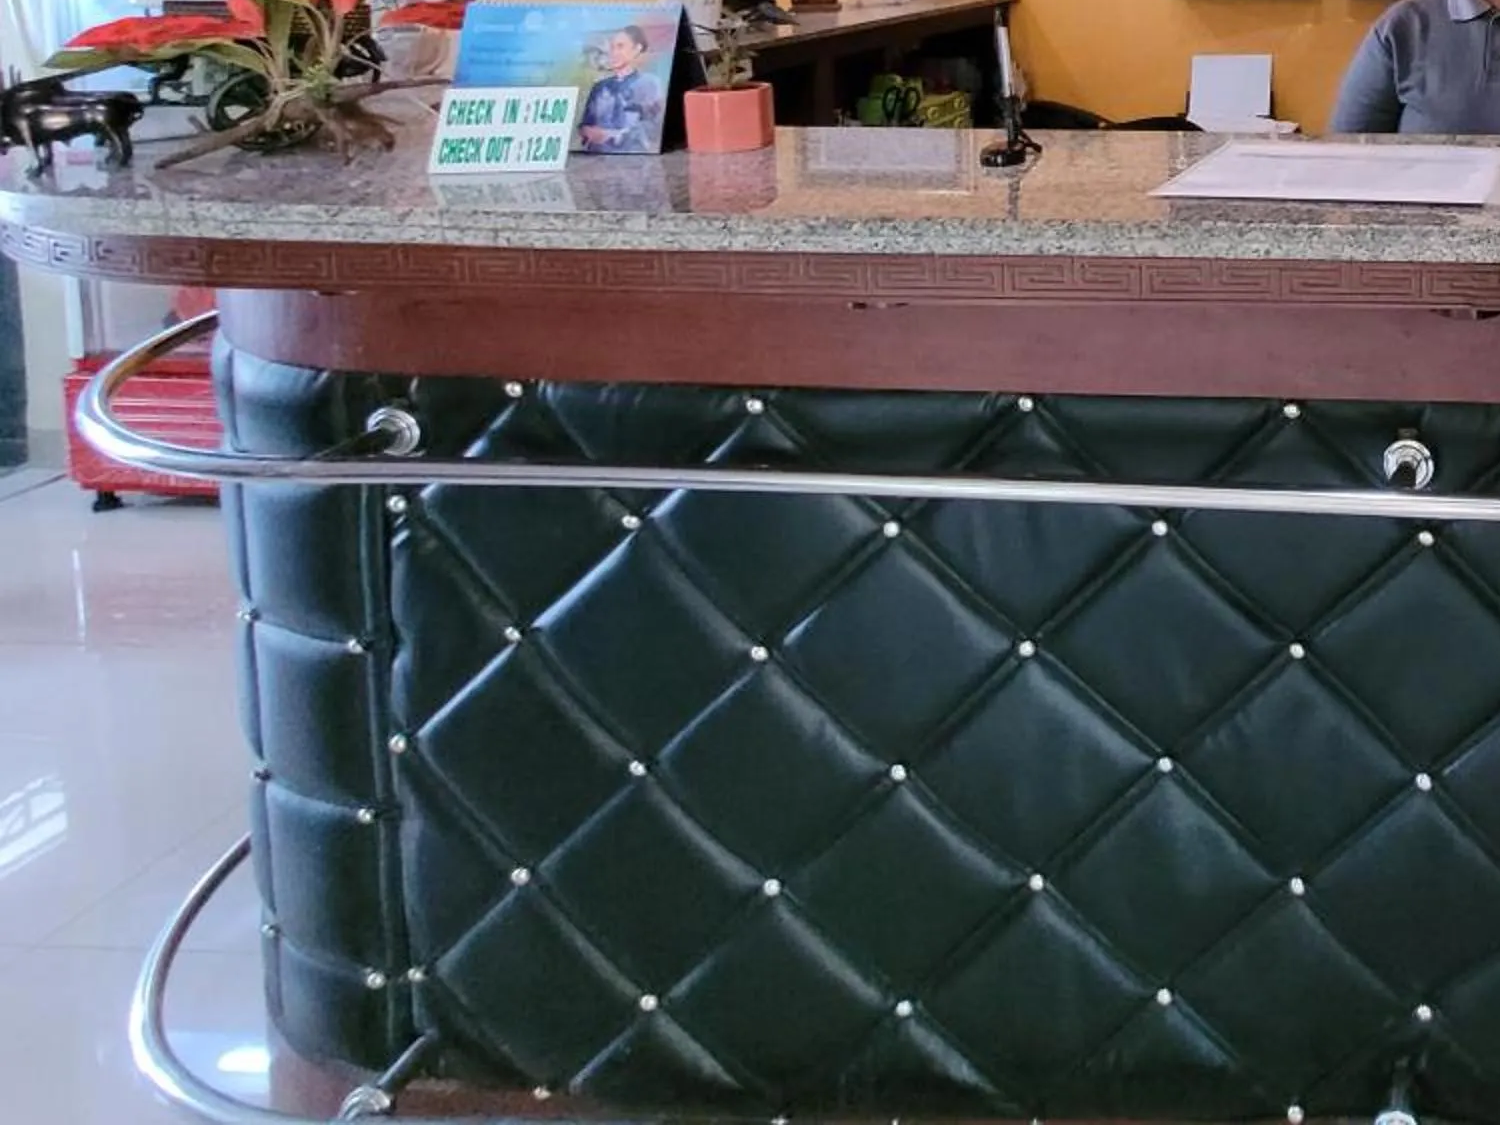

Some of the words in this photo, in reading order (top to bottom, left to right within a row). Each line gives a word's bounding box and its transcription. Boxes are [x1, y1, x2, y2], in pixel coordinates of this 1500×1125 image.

[446, 99, 496, 125] CHECK
[503, 98, 521, 124] IN
[438, 137, 484, 164] CHECK
[485, 136, 514, 162] OUT
